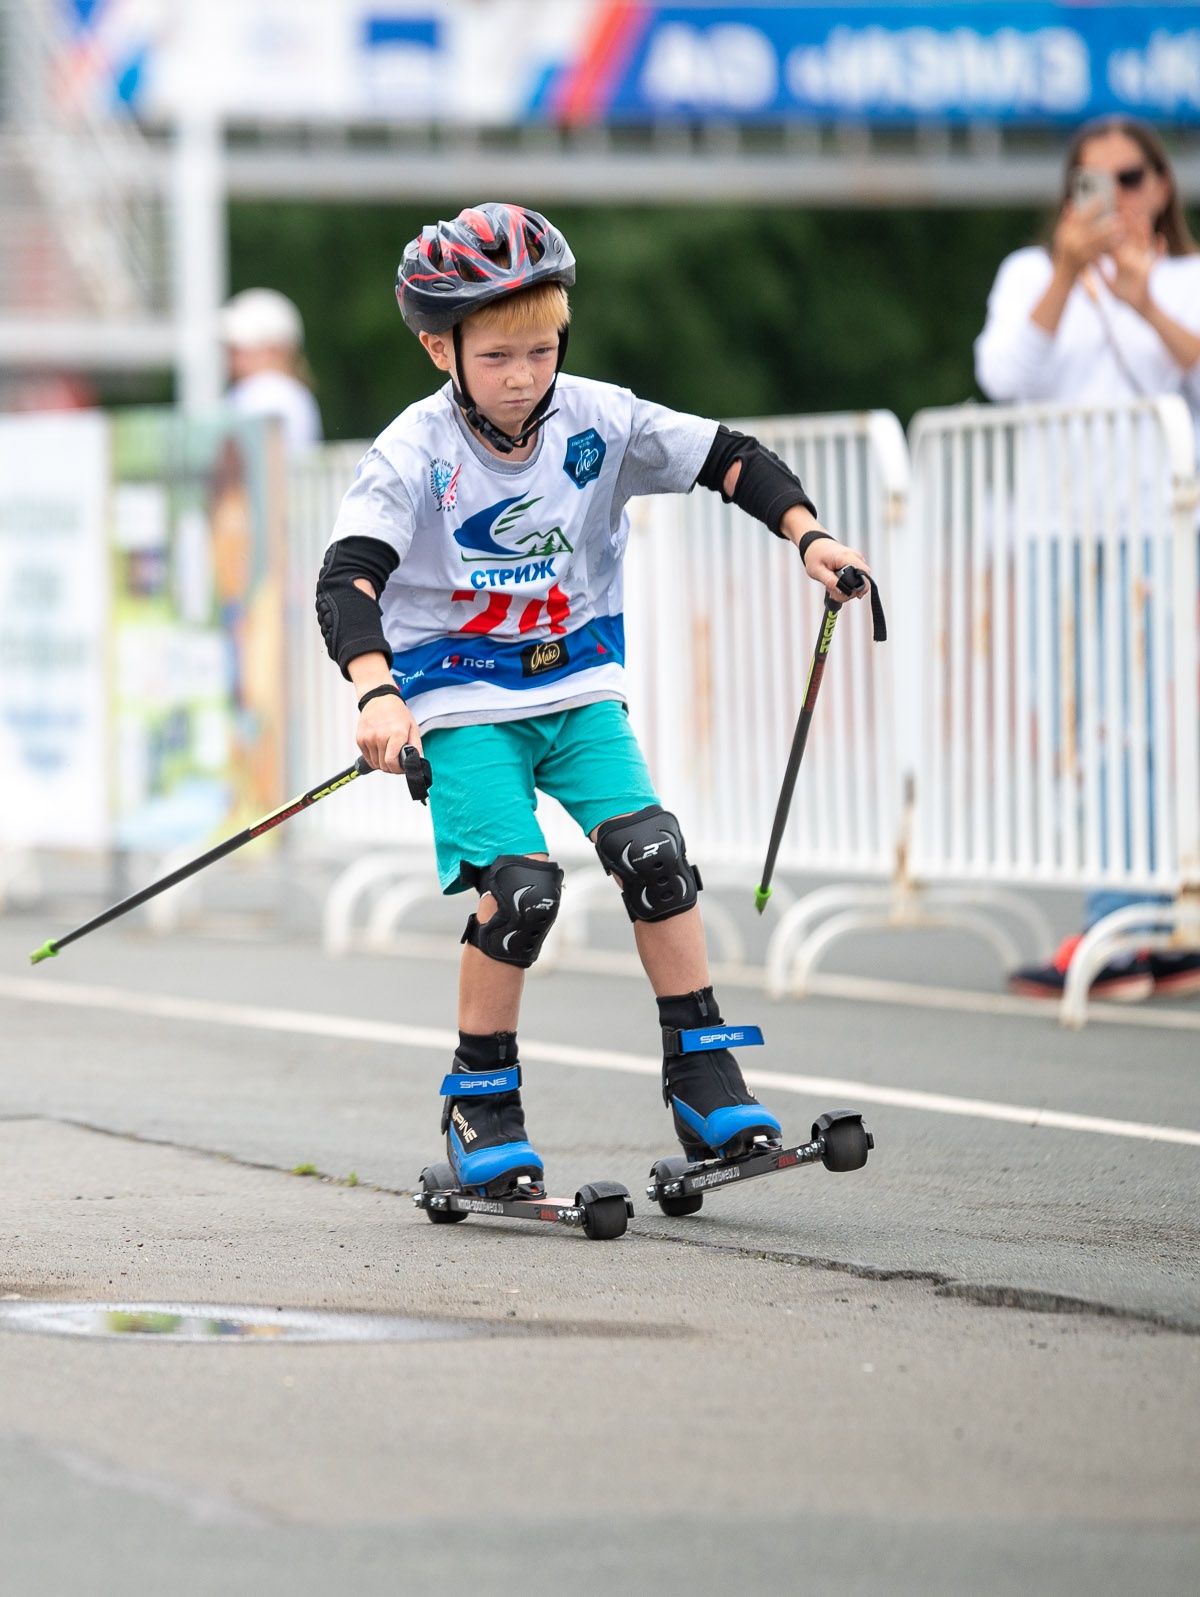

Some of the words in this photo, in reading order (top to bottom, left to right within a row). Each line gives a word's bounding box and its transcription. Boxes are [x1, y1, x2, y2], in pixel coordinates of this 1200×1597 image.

[470, 557, 557, 590] СТРИЖ
[463, 657, 496, 670] ПСБ
[700, 1032, 745, 1045] SPINE
[459, 1077, 508, 1089] SPINE
[451, 1104, 478, 1144] SPINE
